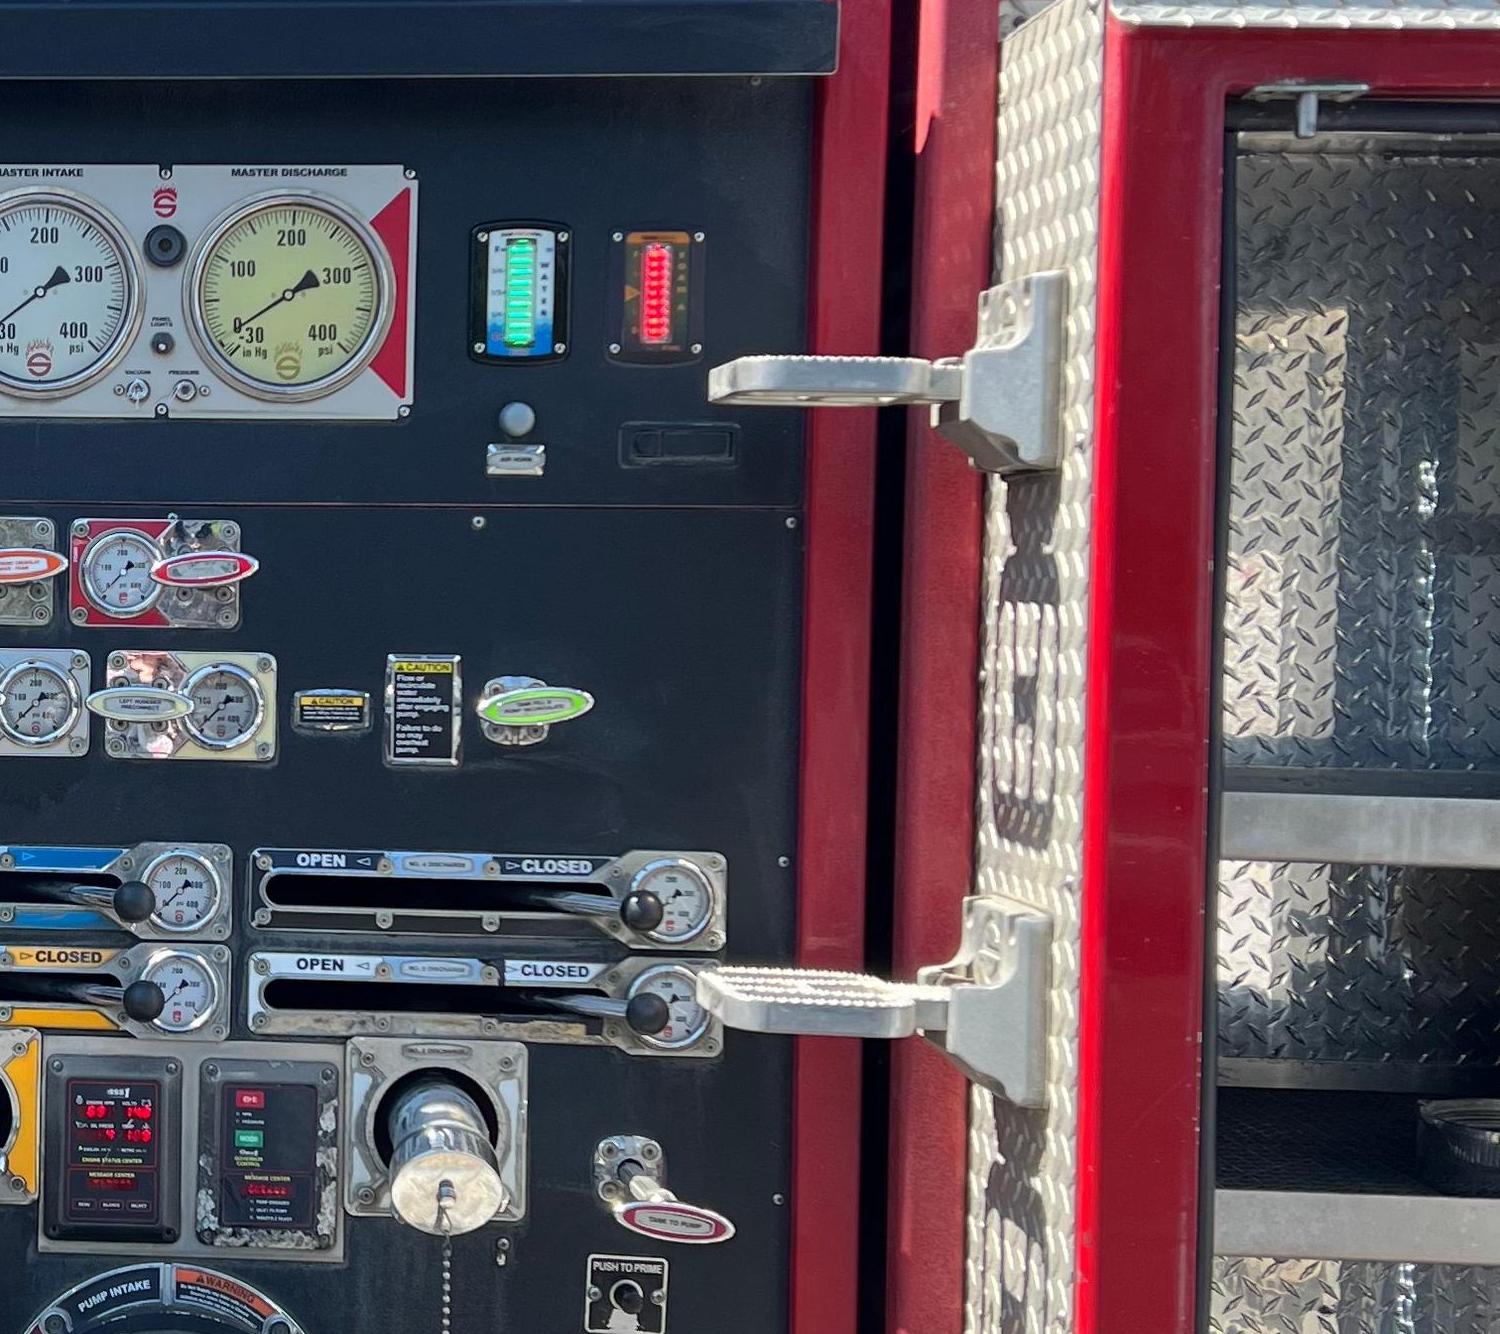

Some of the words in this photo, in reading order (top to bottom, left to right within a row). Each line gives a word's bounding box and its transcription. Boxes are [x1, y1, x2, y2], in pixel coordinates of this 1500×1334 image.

[42, 168, 84, 177] INTAKE
[231, 168, 279, 177] MASTER
[282, 168, 348, 177] DISCHARGE
[30, 226, 59, 244] 200
[277, 229, 306, 247] 200
[74, 266, 103, 283] 300
[230, 260, 256, 277] 100
[322, 267, 351, 284] 300
[59, 321, 88, 339] 400
[233, 317, 242, 333] 0
[308, 323, 337, 341] 400
[6, 343, 19, 356] Hg
[69, 343, 84, 355] psi
[242, 347, 251, 357] in
[254, 347, 268, 359] Hg
[318, 346, 333, 357] psi
[406, 663, 450, 672] CAUTION
[296, 852, 346, 867] OPEN
[521, 859, 593, 874] CLOSED
[174, 867, 188, 876] 200
[158, 881, 172, 889] 100
[35, 950, 102, 963] CLOSED
[296, 957, 344, 971] OPEN
[521, 964, 589, 978] CLOSED
[592, 1261, 619, 1272] PUSH
[619, 1262, 633, 1272] TO
[633, 1262, 663, 1275] PRIME
[77, 1290, 108, 1313] PUMP
[109, 1279, 152, 1298] INTAKE
[206, 1275, 256, 1304] WARNING
